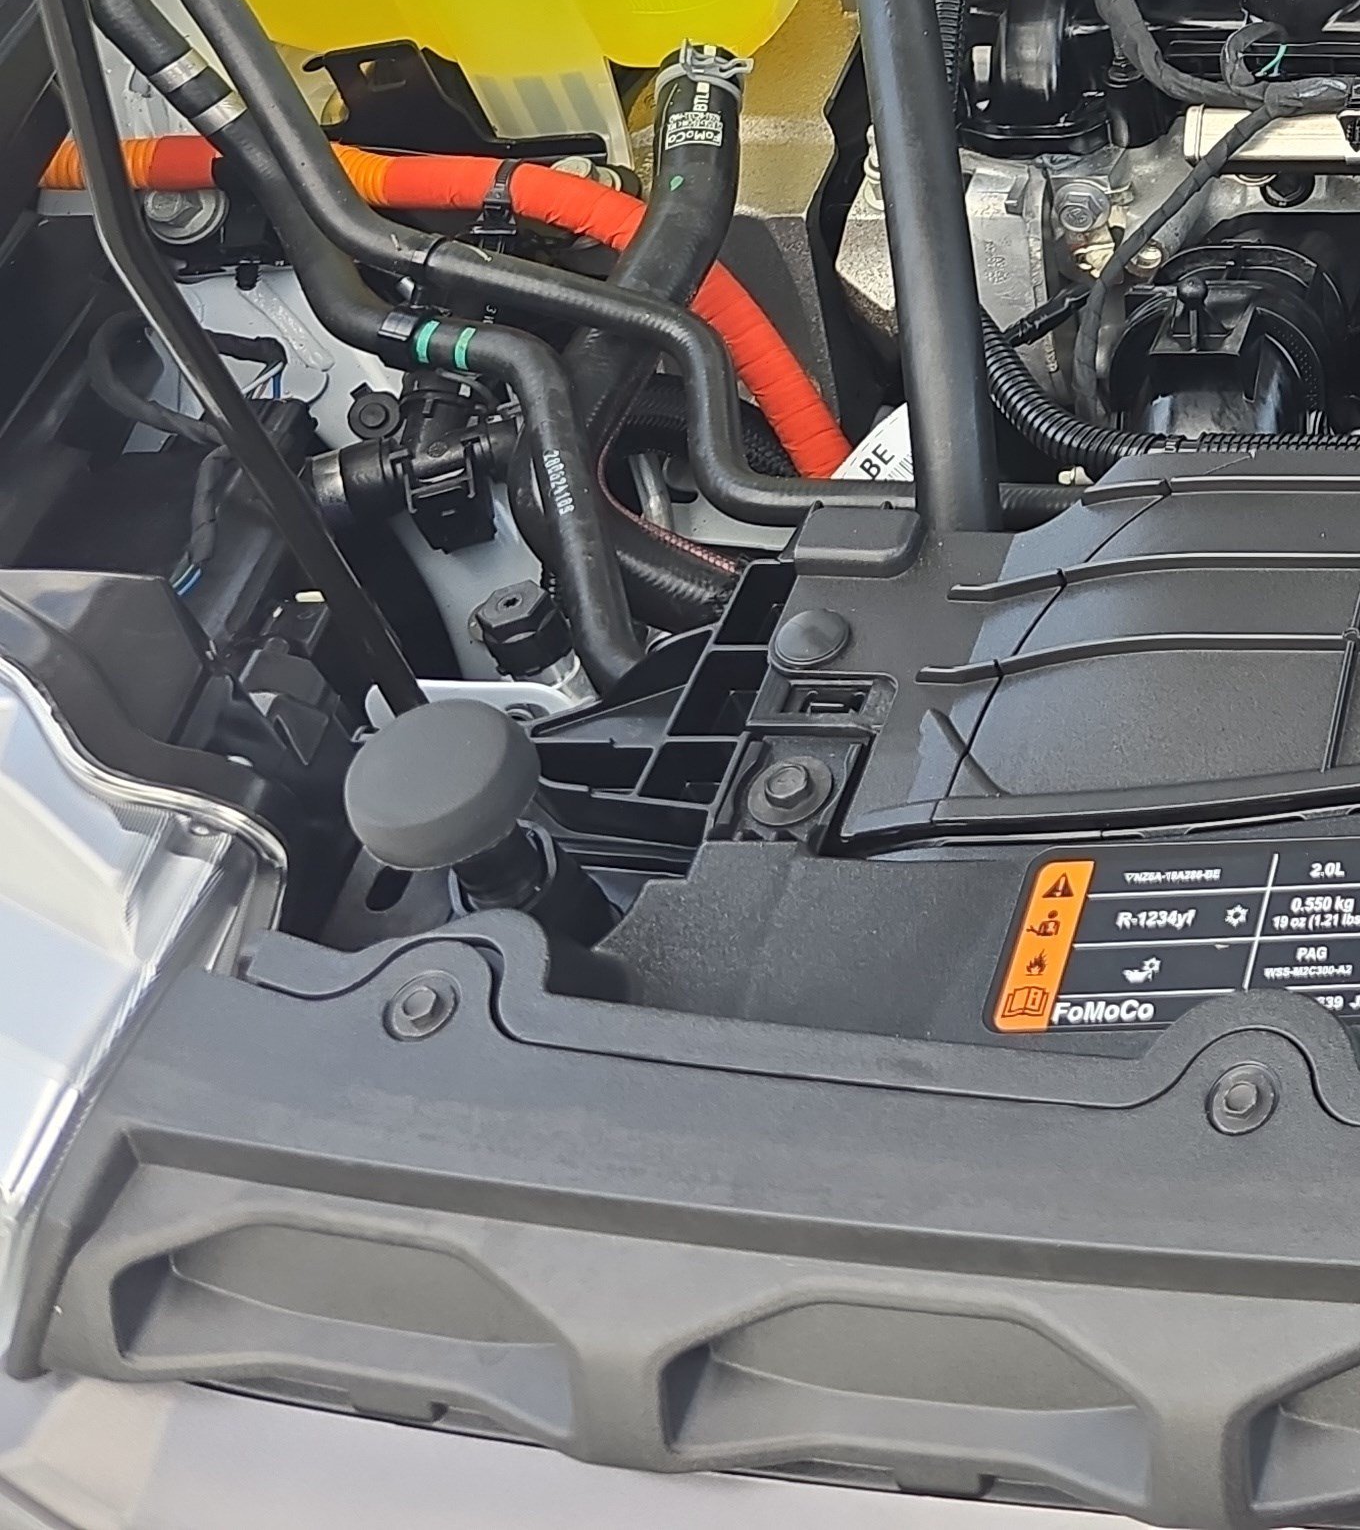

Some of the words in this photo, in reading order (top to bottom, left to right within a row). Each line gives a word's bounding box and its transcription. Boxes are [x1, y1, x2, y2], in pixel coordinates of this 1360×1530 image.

[668, 129, 723, 144] FoMoCo
[860, 443, 896, 481] BE
[1309, 862, 1345, 879] 2.0L
[1290, 897, 1332, 913] 0.550
[1334, 896, 1355, 914] kg
[1115, 909, 1197, 931] R-1234yf
[1272, 916, 1288, 929] 19
[1290, 918, 1306, 929] oz
[1308, 914, 1338, 930] (1.21
[1296, 946, 1328, 962] PAG
[1052, 999, 1155, 1024] FoMoCo
